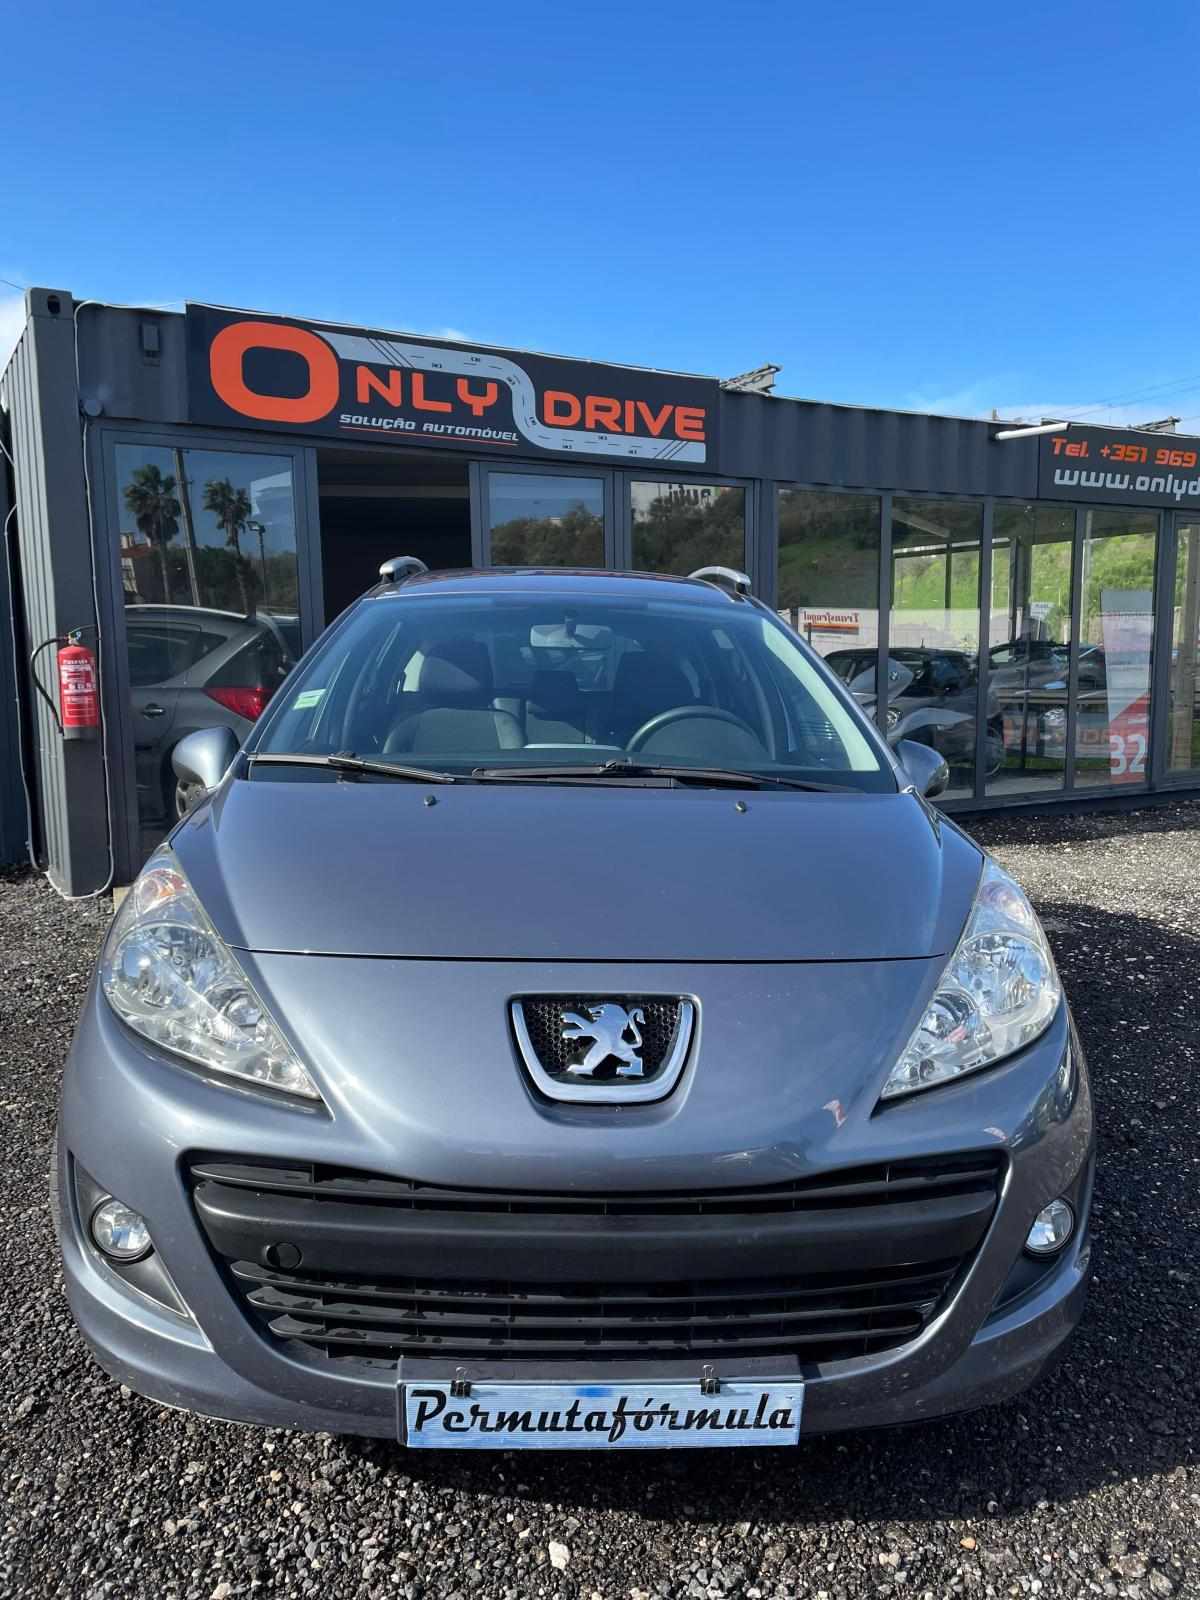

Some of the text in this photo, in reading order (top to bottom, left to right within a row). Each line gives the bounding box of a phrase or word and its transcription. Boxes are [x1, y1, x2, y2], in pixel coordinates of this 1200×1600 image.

[209, 321, 705, 440] ONLY DRIVE
[339, 413, 519, 441] SOLUÇÃO AUTOMÓVEL
[1052, 438, 1197, 467] Tel. +351 969
[410, 1389, 795, 1443] Permutafórmula
